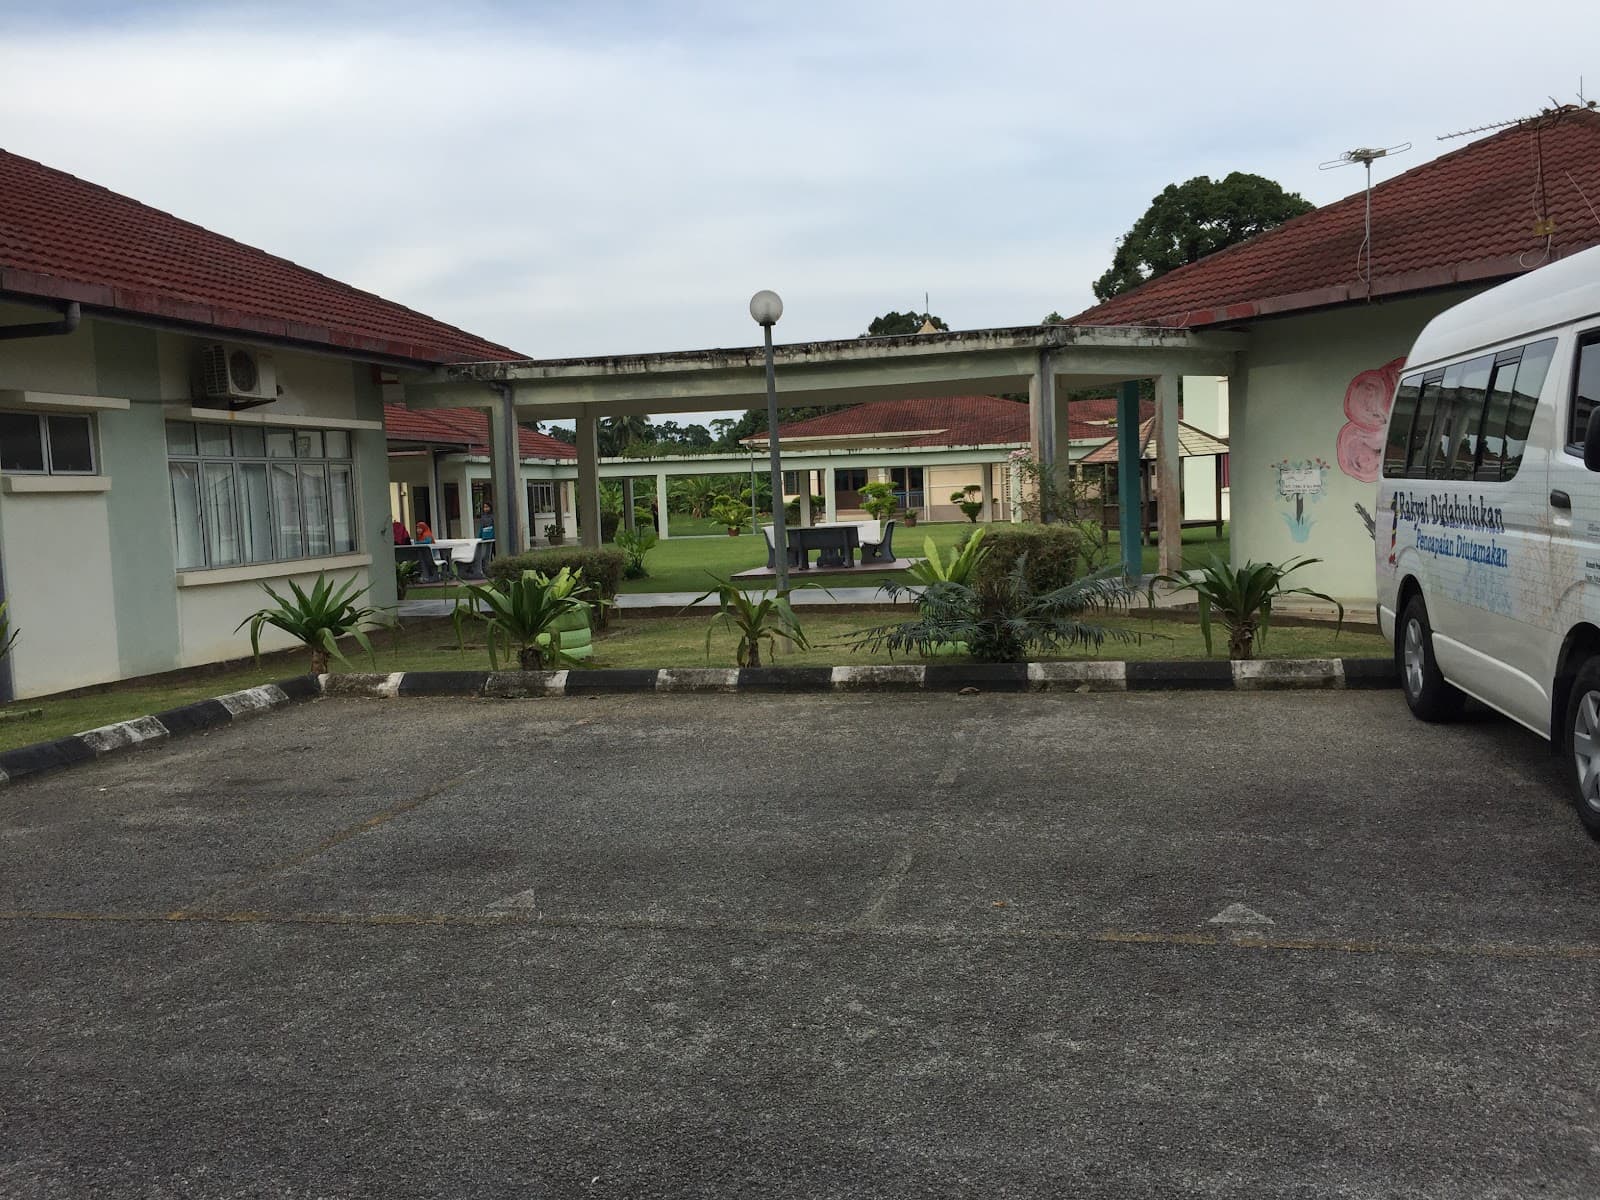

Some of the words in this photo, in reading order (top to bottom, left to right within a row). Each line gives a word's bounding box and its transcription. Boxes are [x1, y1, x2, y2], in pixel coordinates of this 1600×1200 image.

[1399, 491, 1429, 530] Rakyat
[1431, 492, 1505, 533] Didahulukan
[1455, 534, 1508, 568] Diutamakan
